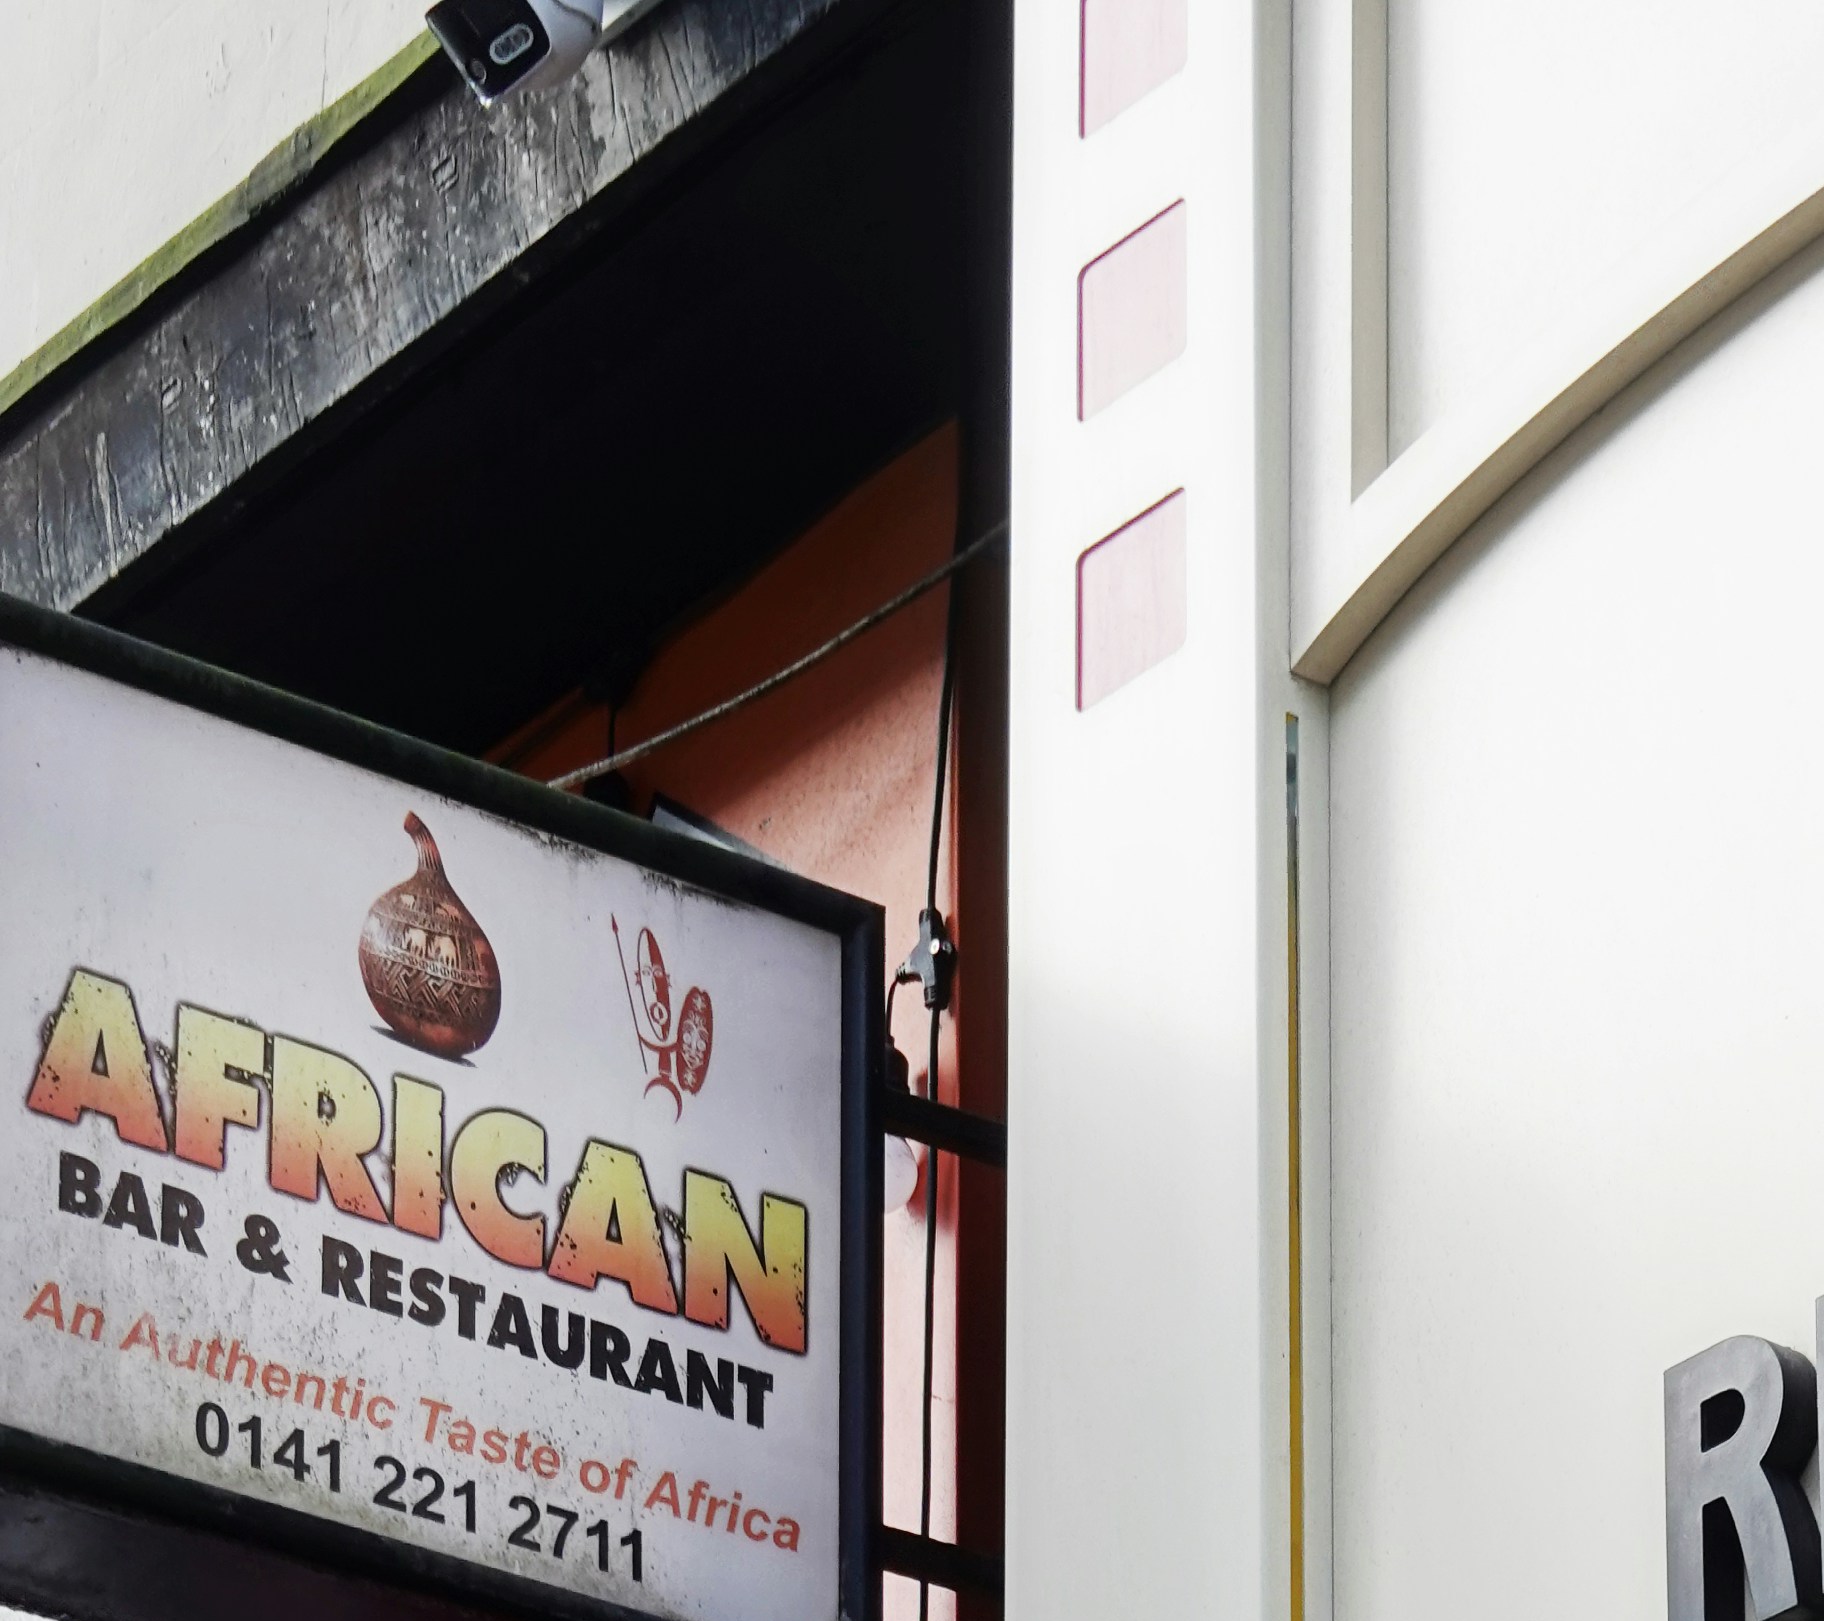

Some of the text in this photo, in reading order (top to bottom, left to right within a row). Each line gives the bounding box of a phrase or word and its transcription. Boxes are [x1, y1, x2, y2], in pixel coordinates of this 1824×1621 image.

[27, 967, 810, 1355] AFRICAN
[59, 1151, 774, 1429] BAR & RESTAURANT
[23, 1281, 803, 1553] An Authentic Taste of Africa
[194, 1402, 646, 1583] 0141 221 2711
